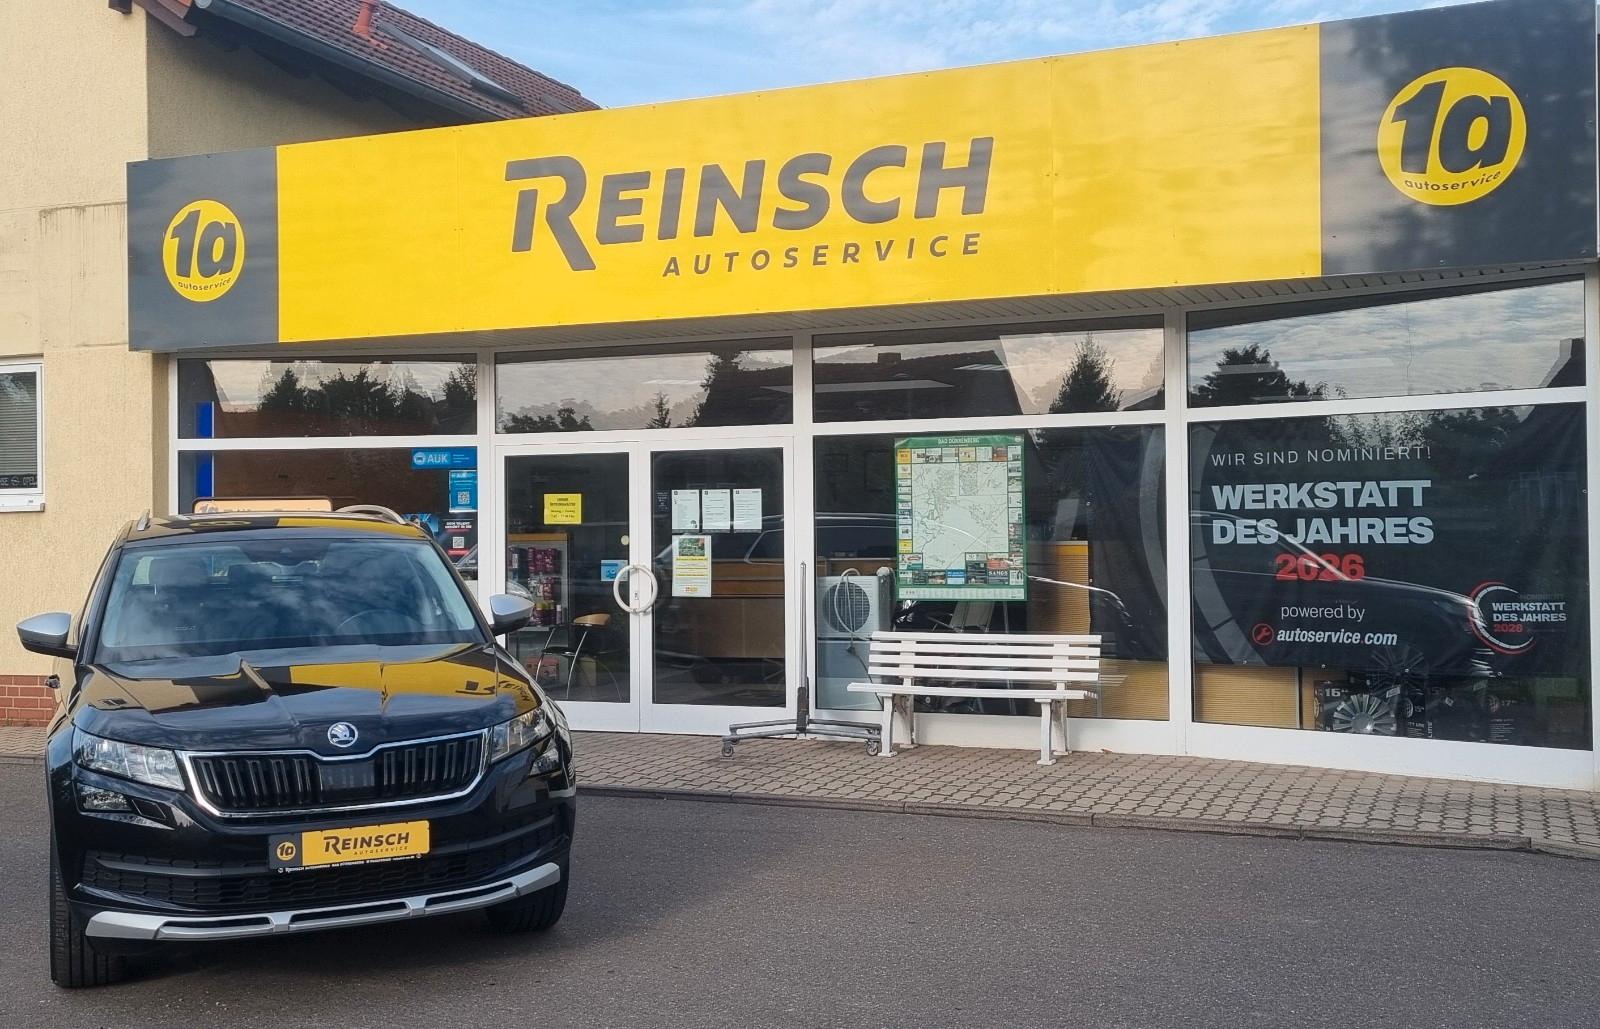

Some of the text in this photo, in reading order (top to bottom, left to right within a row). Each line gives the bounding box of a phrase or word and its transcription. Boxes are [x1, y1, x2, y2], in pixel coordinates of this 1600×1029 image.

[1391, 80, 1512, 174] 1a
[1404, 170, 1501, 191] autoservice
[505, 136, 994, 272] REINSCH
[170, 209, 235, 279] 1a
[663, 232, 981, 277] AUTOSERVICE
[178, 277, 231, 291] autoservice
[427, 454, 448, 465] AUK
[1211, 446, 1433, 467] WIR SIND NOMINIERT!
[1211, 480, 1432, 511] WERKSTATT
[1212, 516, 1435, 545] DES JAHRES
[1274, 553, 1366, 582] 2026
[1280, 604, 1366, 622] powered by
[1492, 602, 1566, 611] WERKSTATT
[1493, 612, 1567, 622] DES JAHRES
[1276, 628, 1398, 646] autoservice.com
[323, 831, 409, 855] REINSCH
[353, 846, 409, 856] AUTOSERVICE
